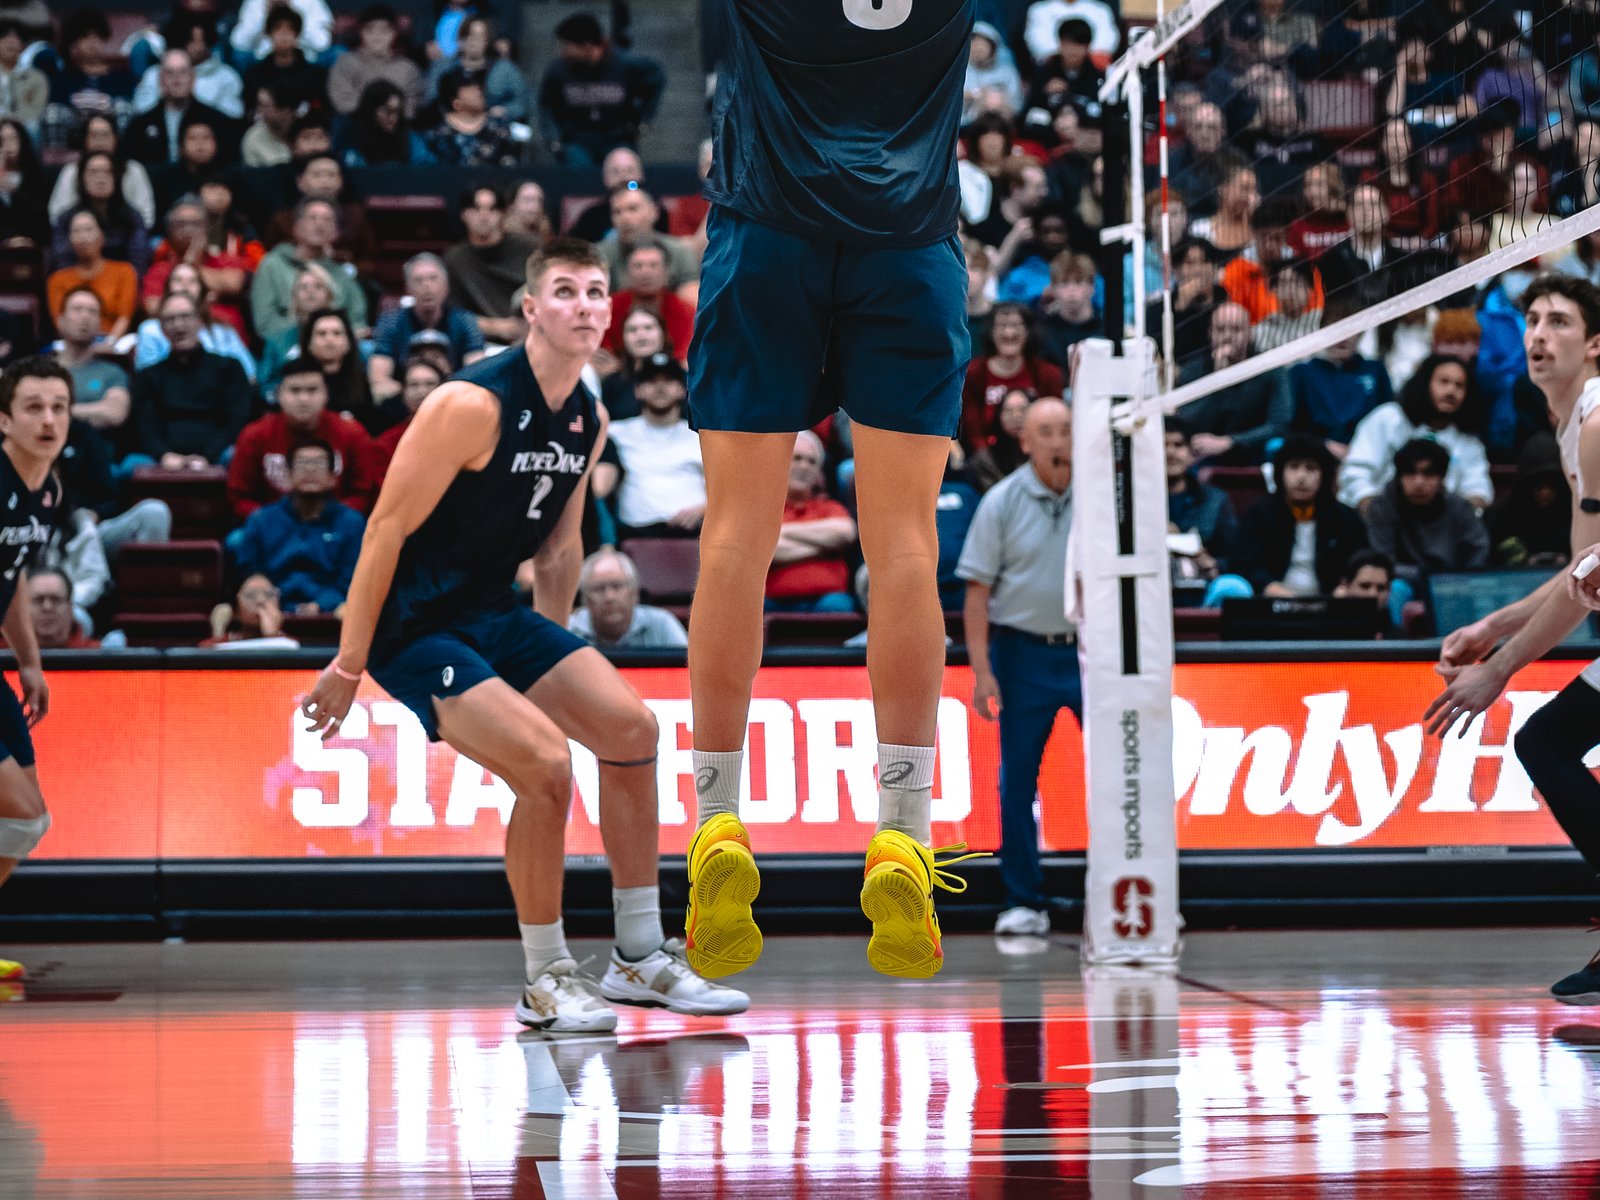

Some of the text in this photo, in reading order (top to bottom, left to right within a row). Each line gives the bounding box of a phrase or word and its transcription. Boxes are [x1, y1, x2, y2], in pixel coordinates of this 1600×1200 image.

[526, 474, 554, 520] 2
[1119, 708, 1143, 861] sports imports
